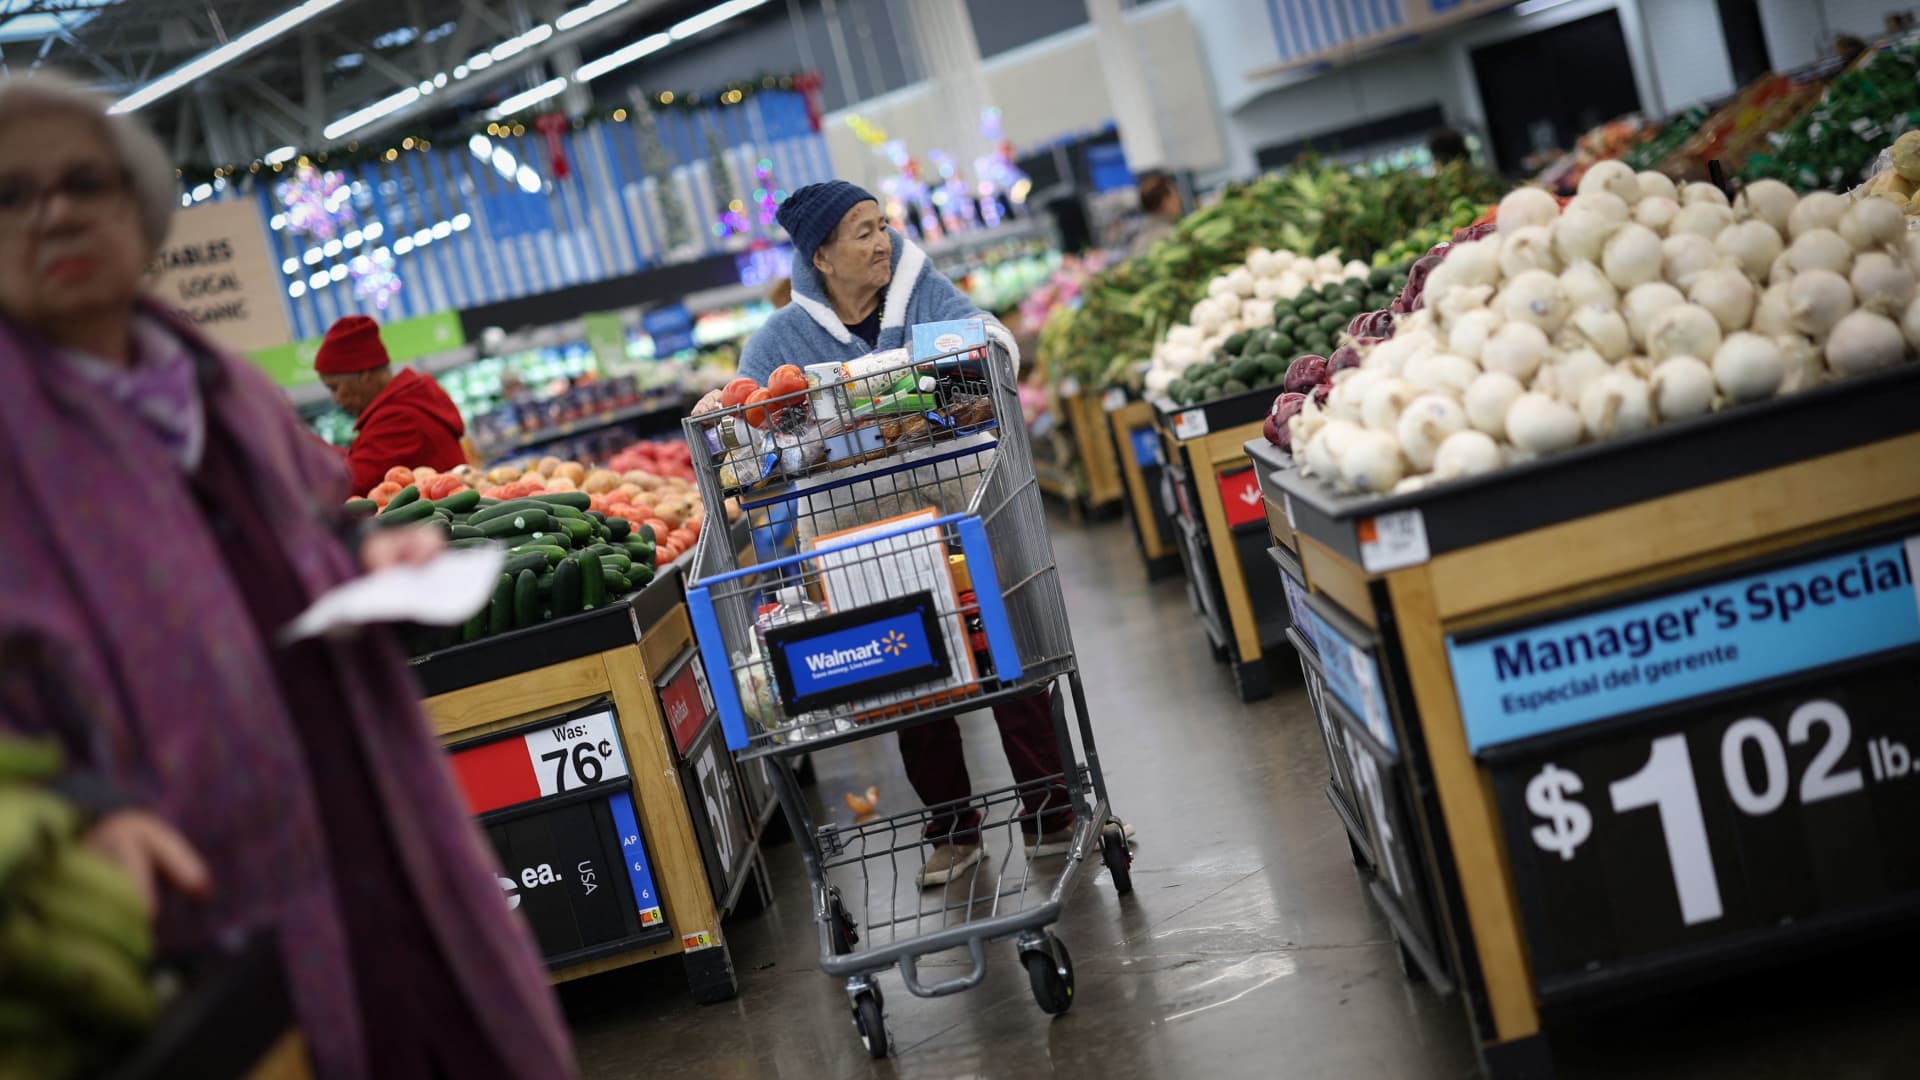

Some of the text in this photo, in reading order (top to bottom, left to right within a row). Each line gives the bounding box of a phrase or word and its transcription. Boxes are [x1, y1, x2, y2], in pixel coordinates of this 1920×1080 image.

[178, 271, 242, 299] LOCAL
[191, 300, 249, 324] GANIC
[1491, 548, 1912, 683] Manager's Special
[806, 640, 881, 671] Walmart
[1500, 642, 1740, 716] Especial del gerente
[552, 724, 588, 743] Was:
[541, 738, 613, 794] 76¢
[1867, 736, 1920, 782] lb.
[623, 835, 637, 847] AP
[521, 863, 563, 889] ea.
[577, 860, 598, 896] USA
[634, 862, 641, 871] 6
[642, 889, 649, 899] 6
